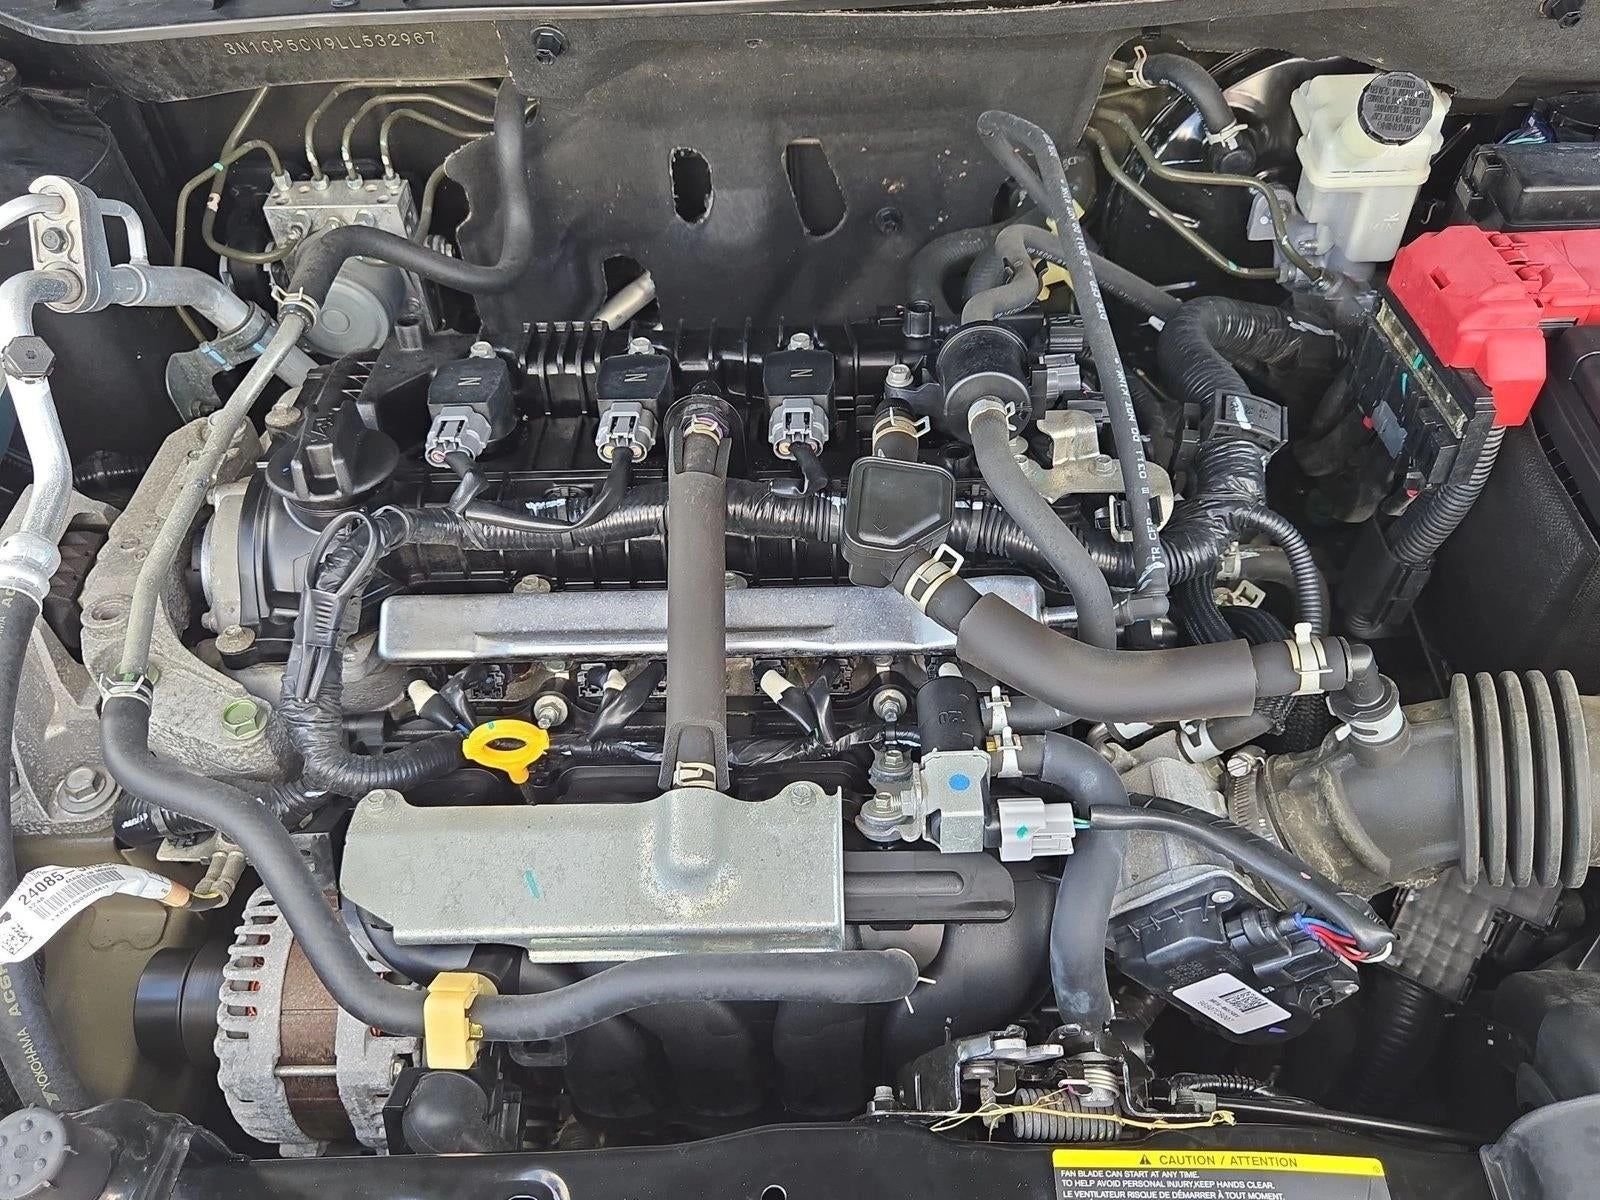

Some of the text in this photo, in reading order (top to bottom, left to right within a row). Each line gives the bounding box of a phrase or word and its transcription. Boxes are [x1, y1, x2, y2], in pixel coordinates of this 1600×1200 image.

[224, 31, 436, 55] 3N1CP5CV9LL532967
[1115, 370, 1130, 396] KINK
[1124, 401, 1136, 422] NOT
[1131, 427, 1140, 442] DO
[1136, 449, 1147, 479] 0311
[1146, 517, 1157, 540] CFP
[16, 1026, 51, 1091] YOKOHAMA
[1159, 1155, 1216, 1165] CAUTION
[1230, 1156, 1298, 1167] ATTENTION
[1060, 1170, 1076, 1178] FAN
[1078, 1170, 1104, 1178] BLADE
[1105, 1170, 1122, 1178] CAN
[1124, 1170, 1149, 1178] START
[1179, 1171, 1200, 1179] TIME.
[1061, 1179, 1073, 1187] TO
[1075, 1179, 1095, 1187] HELP
[1122, 1180, 1166, 1188] PERSONAL
[1216, 1181, 1245, 1189] HANDS
[1246, 1181, 1275, 1190] CLEAR.
[1063, 1190, 1073, 1198] LE
[1074, 1190, 1126, 1198] VENTILATEUR
[1127, 1191, 1157, 1199] RISQUE
[1159, 1191, 1170, 1199] DE
[1171, 1189, 1217, 1199] DÉMARRER
[1225, 1192, 1246, 1200] TOUT
